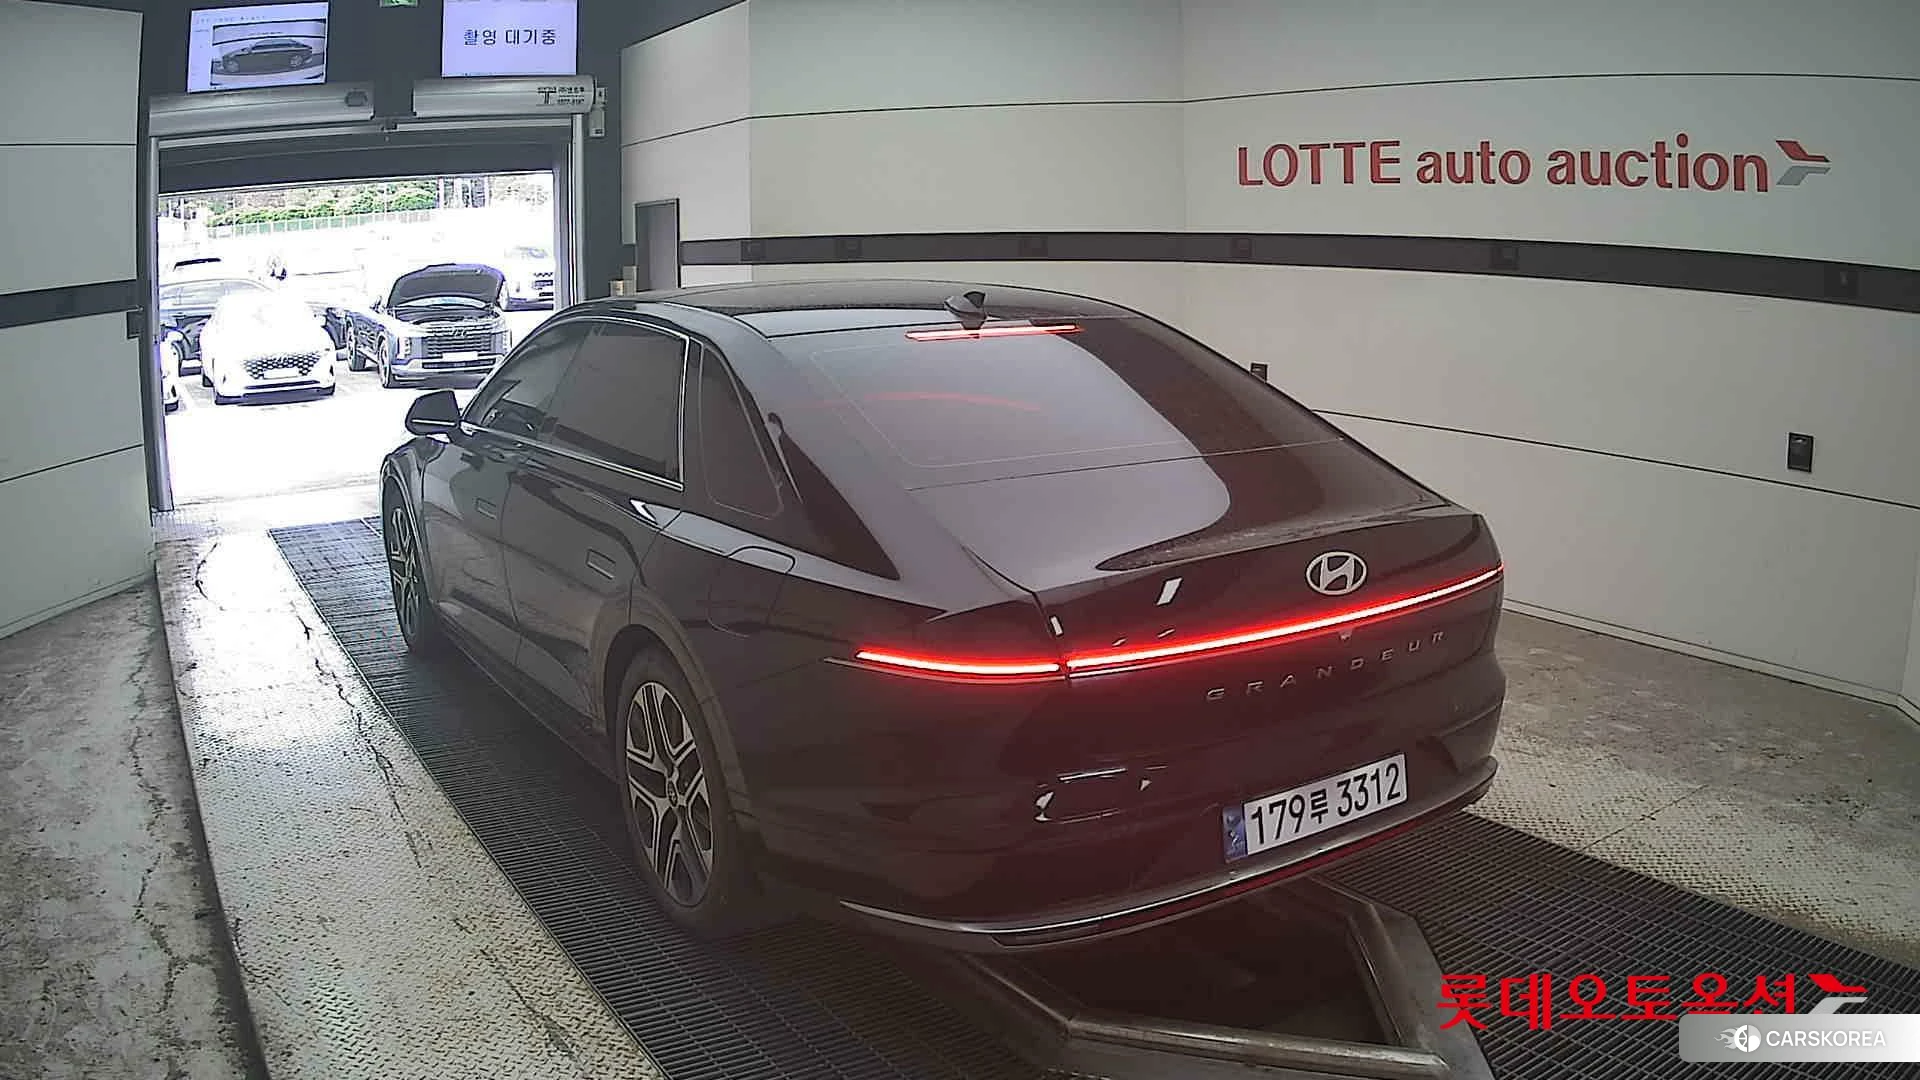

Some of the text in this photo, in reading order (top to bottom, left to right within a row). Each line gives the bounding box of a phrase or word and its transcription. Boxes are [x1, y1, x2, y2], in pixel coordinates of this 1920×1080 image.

[464, 29, 497, 46] 촬영
[1238, 133, 1768, 192] LOTTE auto auction
[1206, 631, 1444, 700] GRANDEUR
[1251, 763, 1401, 845] 179루 3312
